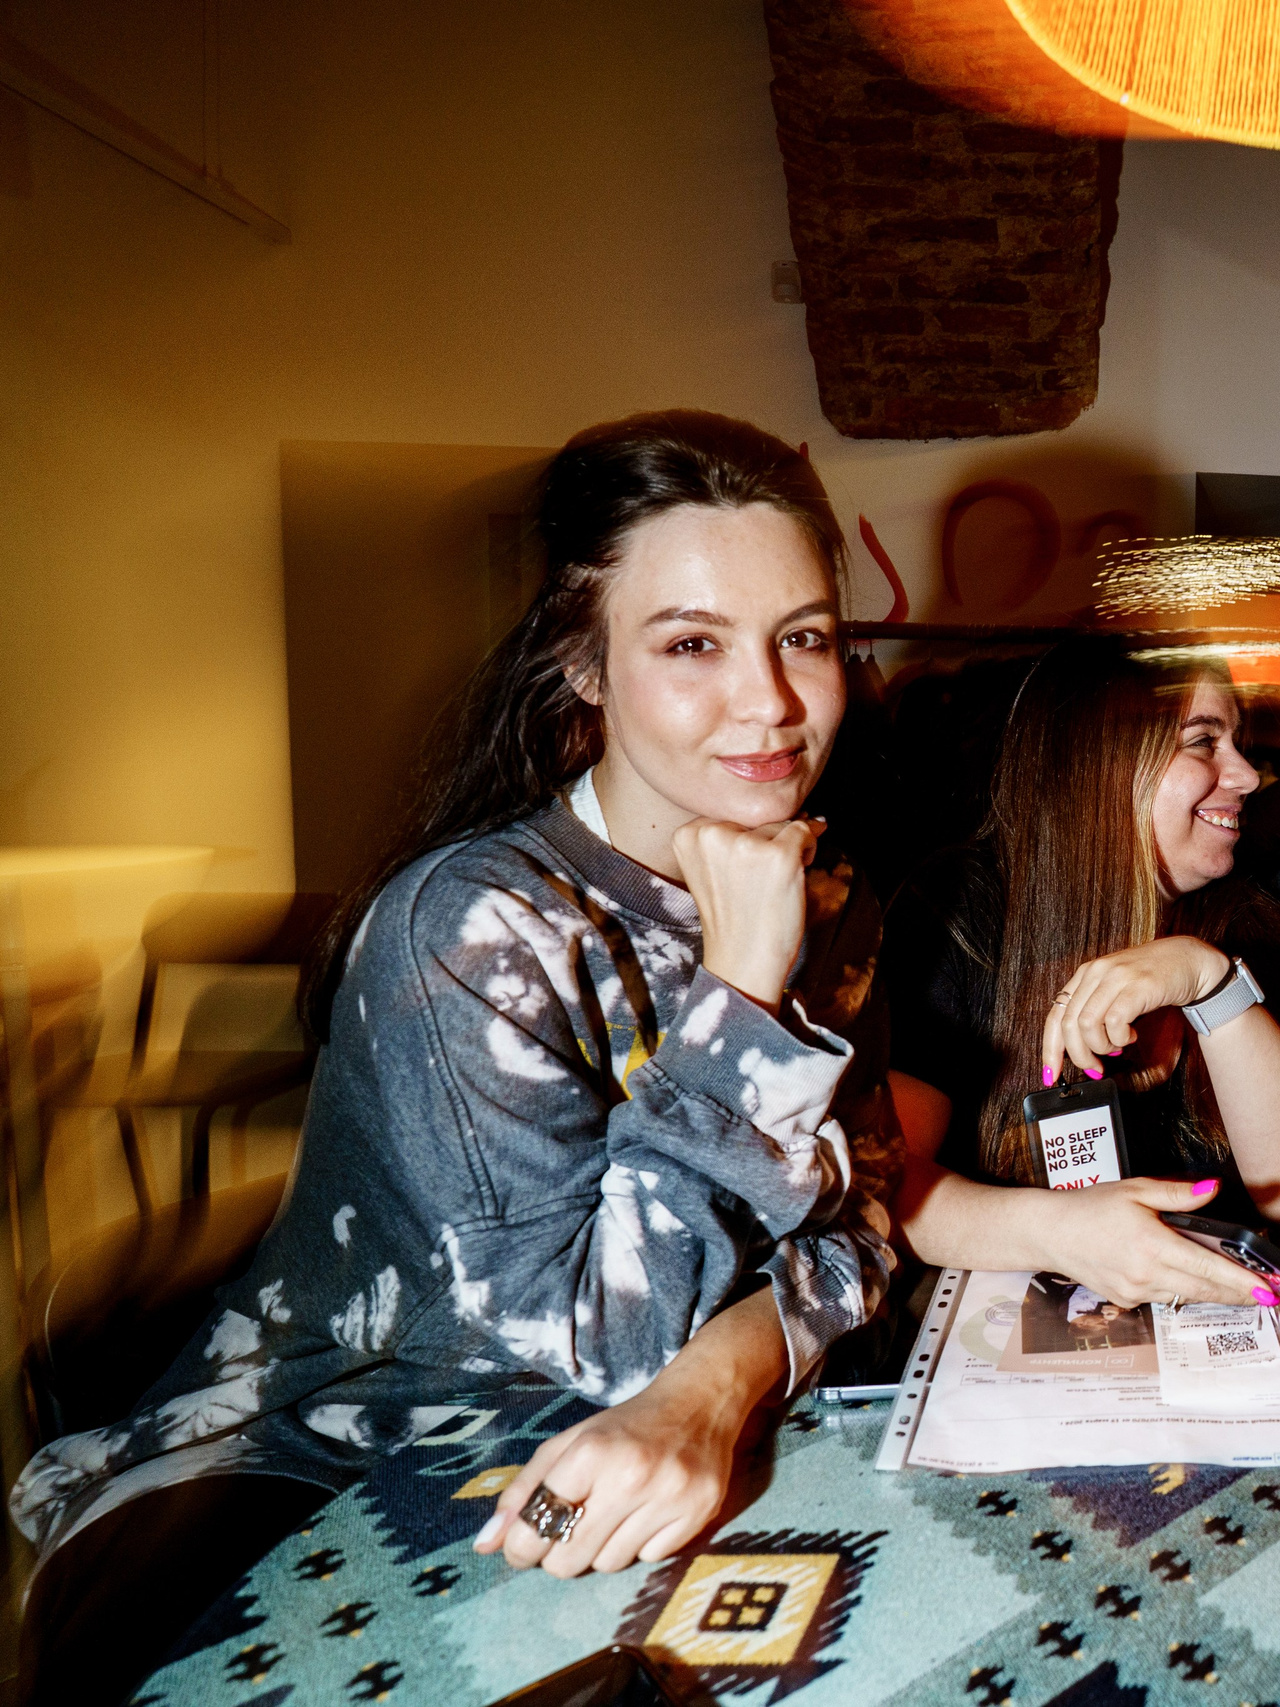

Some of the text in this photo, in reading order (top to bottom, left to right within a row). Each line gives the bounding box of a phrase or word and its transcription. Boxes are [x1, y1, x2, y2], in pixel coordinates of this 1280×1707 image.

[1045, 1126, 1107, 1149] NO SLEEP
[1046, 1140, 1095, 1161] NO EAT
[1048, 1152, 1097, 1172] NO SEX
